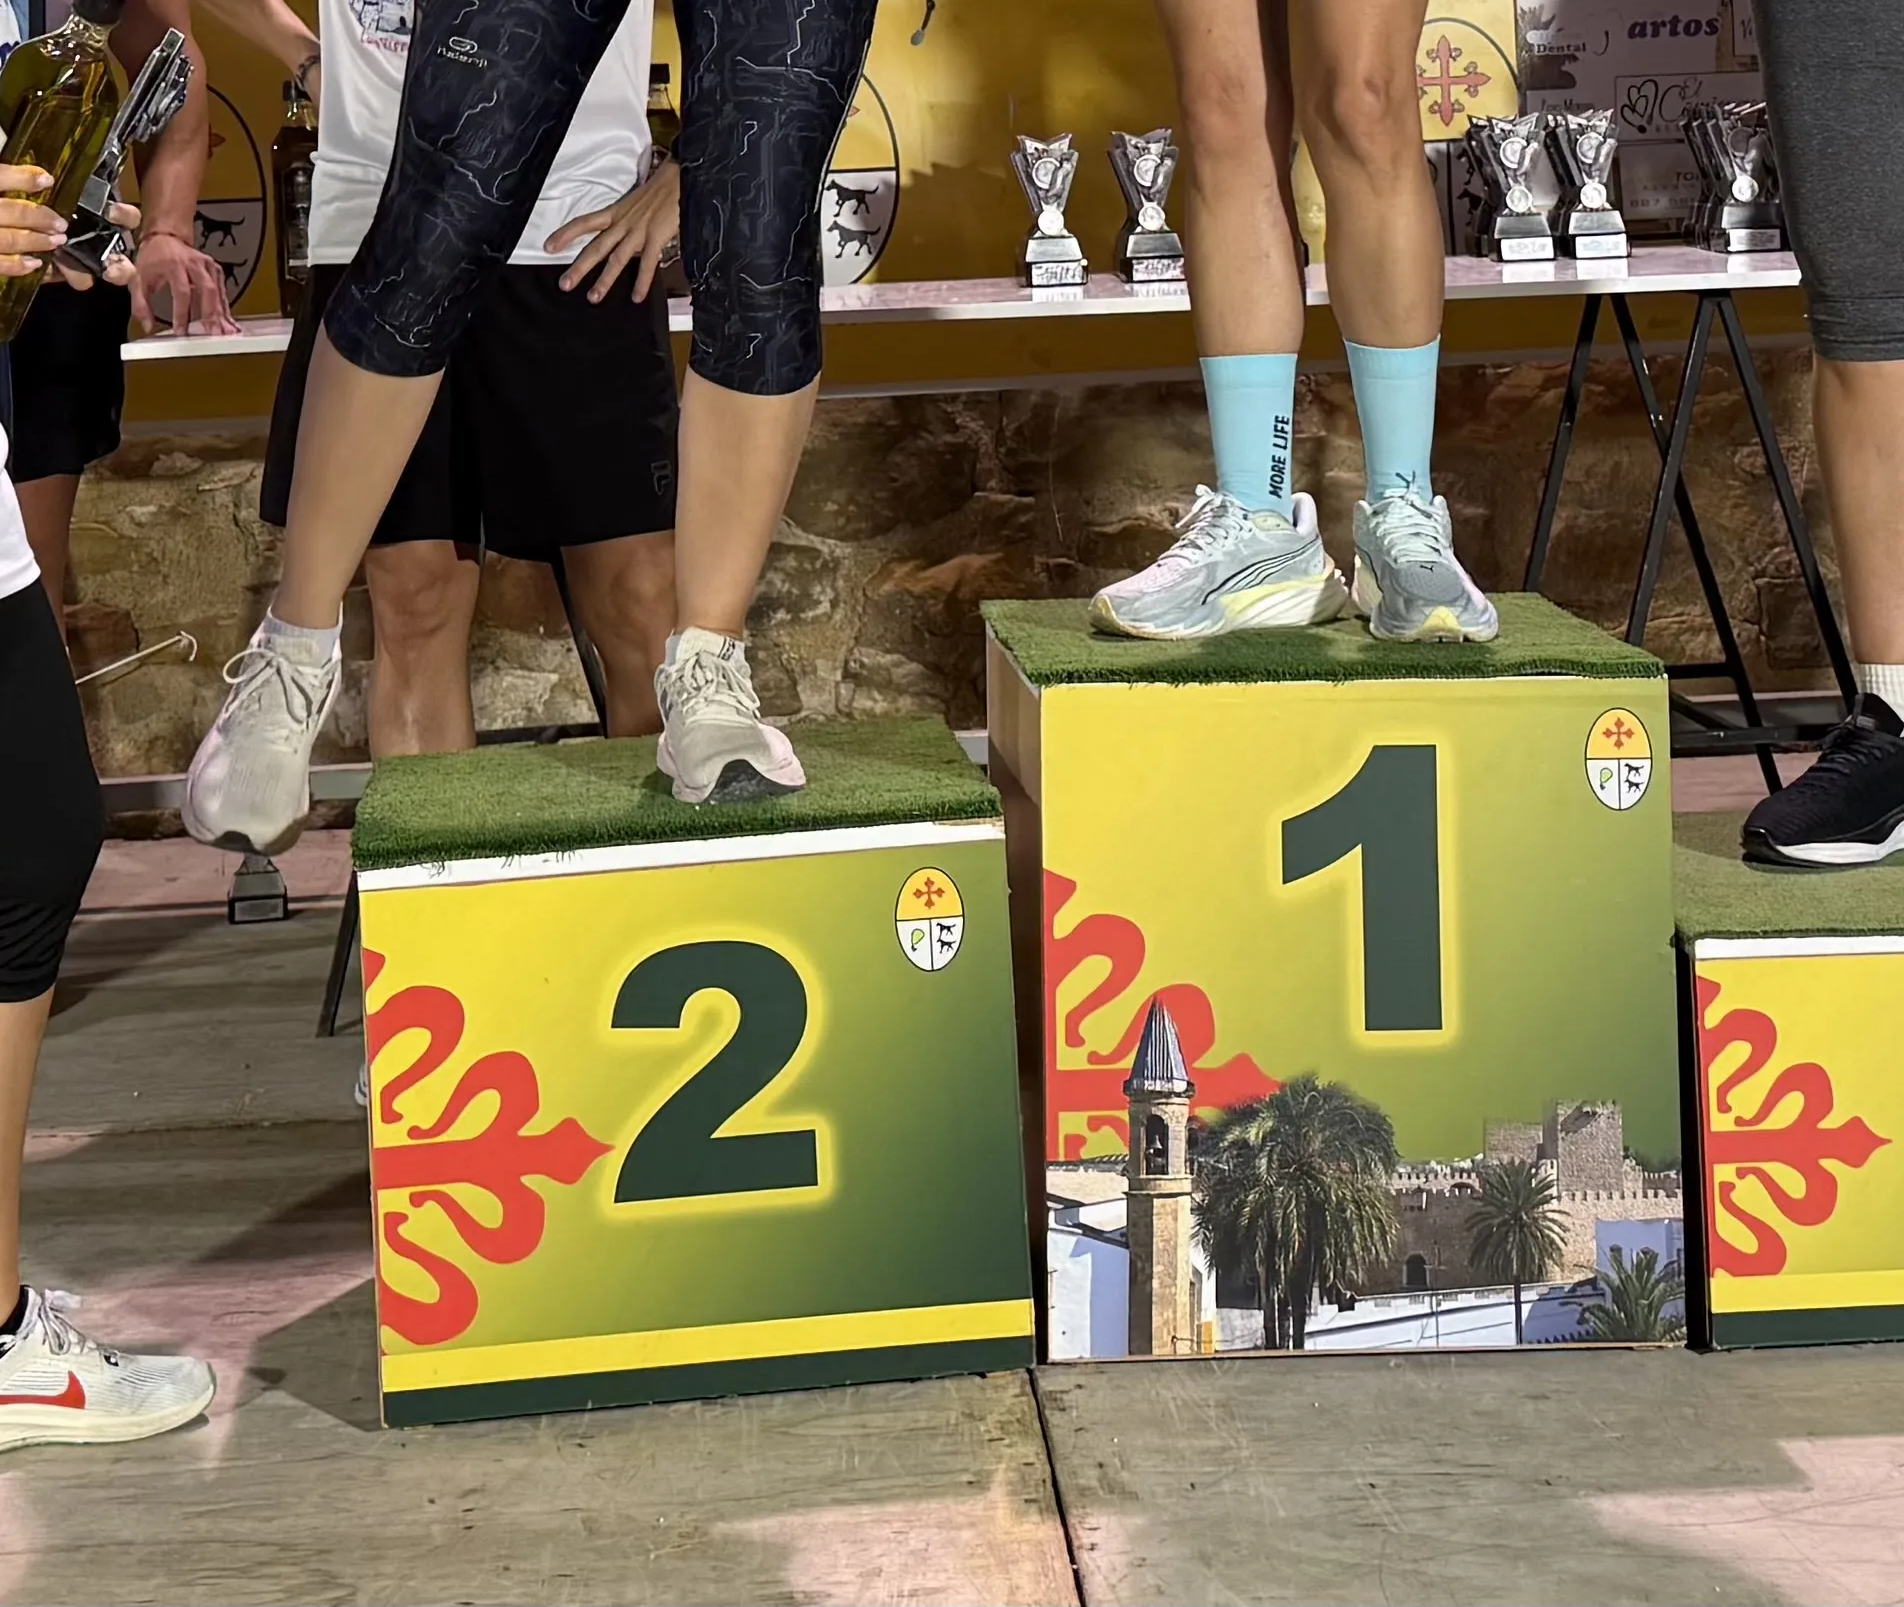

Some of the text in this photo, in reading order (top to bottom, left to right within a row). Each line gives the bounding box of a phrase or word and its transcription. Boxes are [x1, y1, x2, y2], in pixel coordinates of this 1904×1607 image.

[1536, 41, 1586, 54] Dental
[1627, 14, 1720, 41] artos
[1272, 413, 1291, 451] LIFE
[1268, 454, 1288, 499] MORE
[1281, 744, 1444, 1032] 1
[610, 939, 819, 1204] 2
